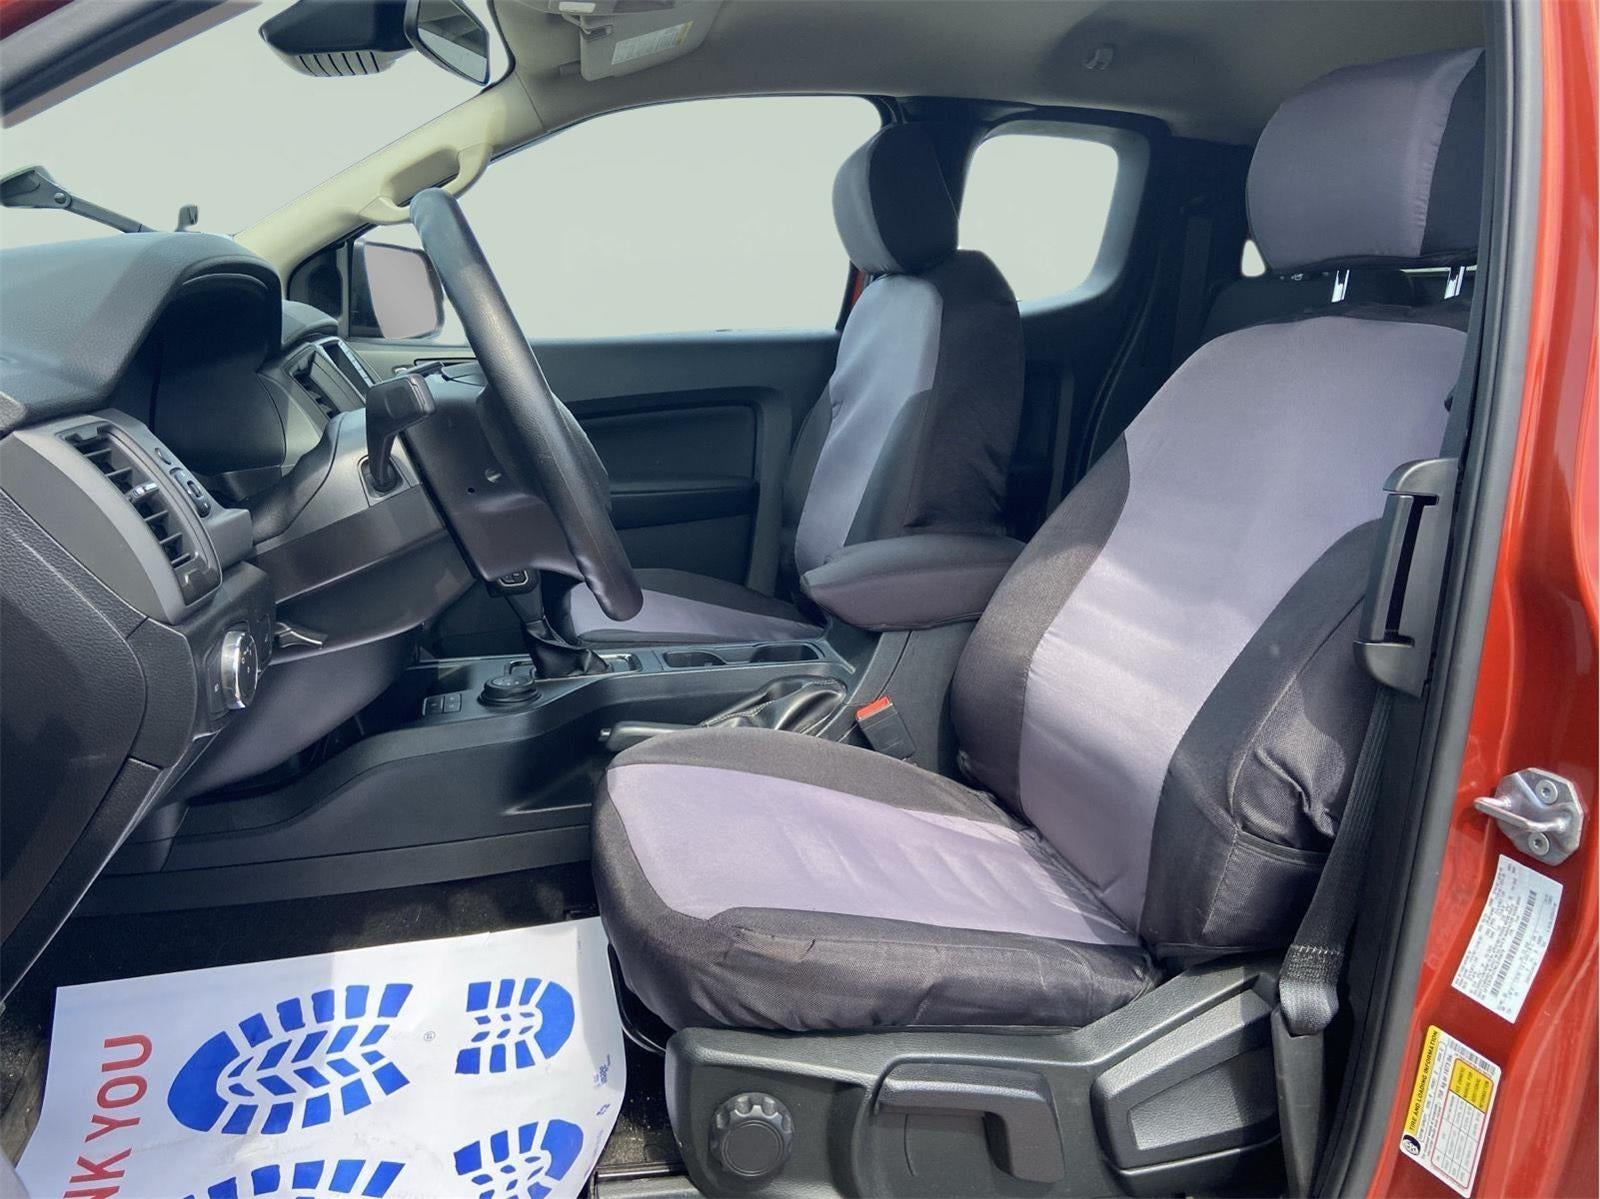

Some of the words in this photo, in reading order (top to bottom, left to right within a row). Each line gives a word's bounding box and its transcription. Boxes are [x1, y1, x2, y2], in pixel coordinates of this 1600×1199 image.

[1423, 1030, 1437, 1074] INFORMATION
[85, 1034, 153, 1142] YOU
[1416, 1074, 1427, 1103] LOADING
[1413, 1100, 1421, 1116] AND
[1409, 1115, 1418, 1131] TIRE
